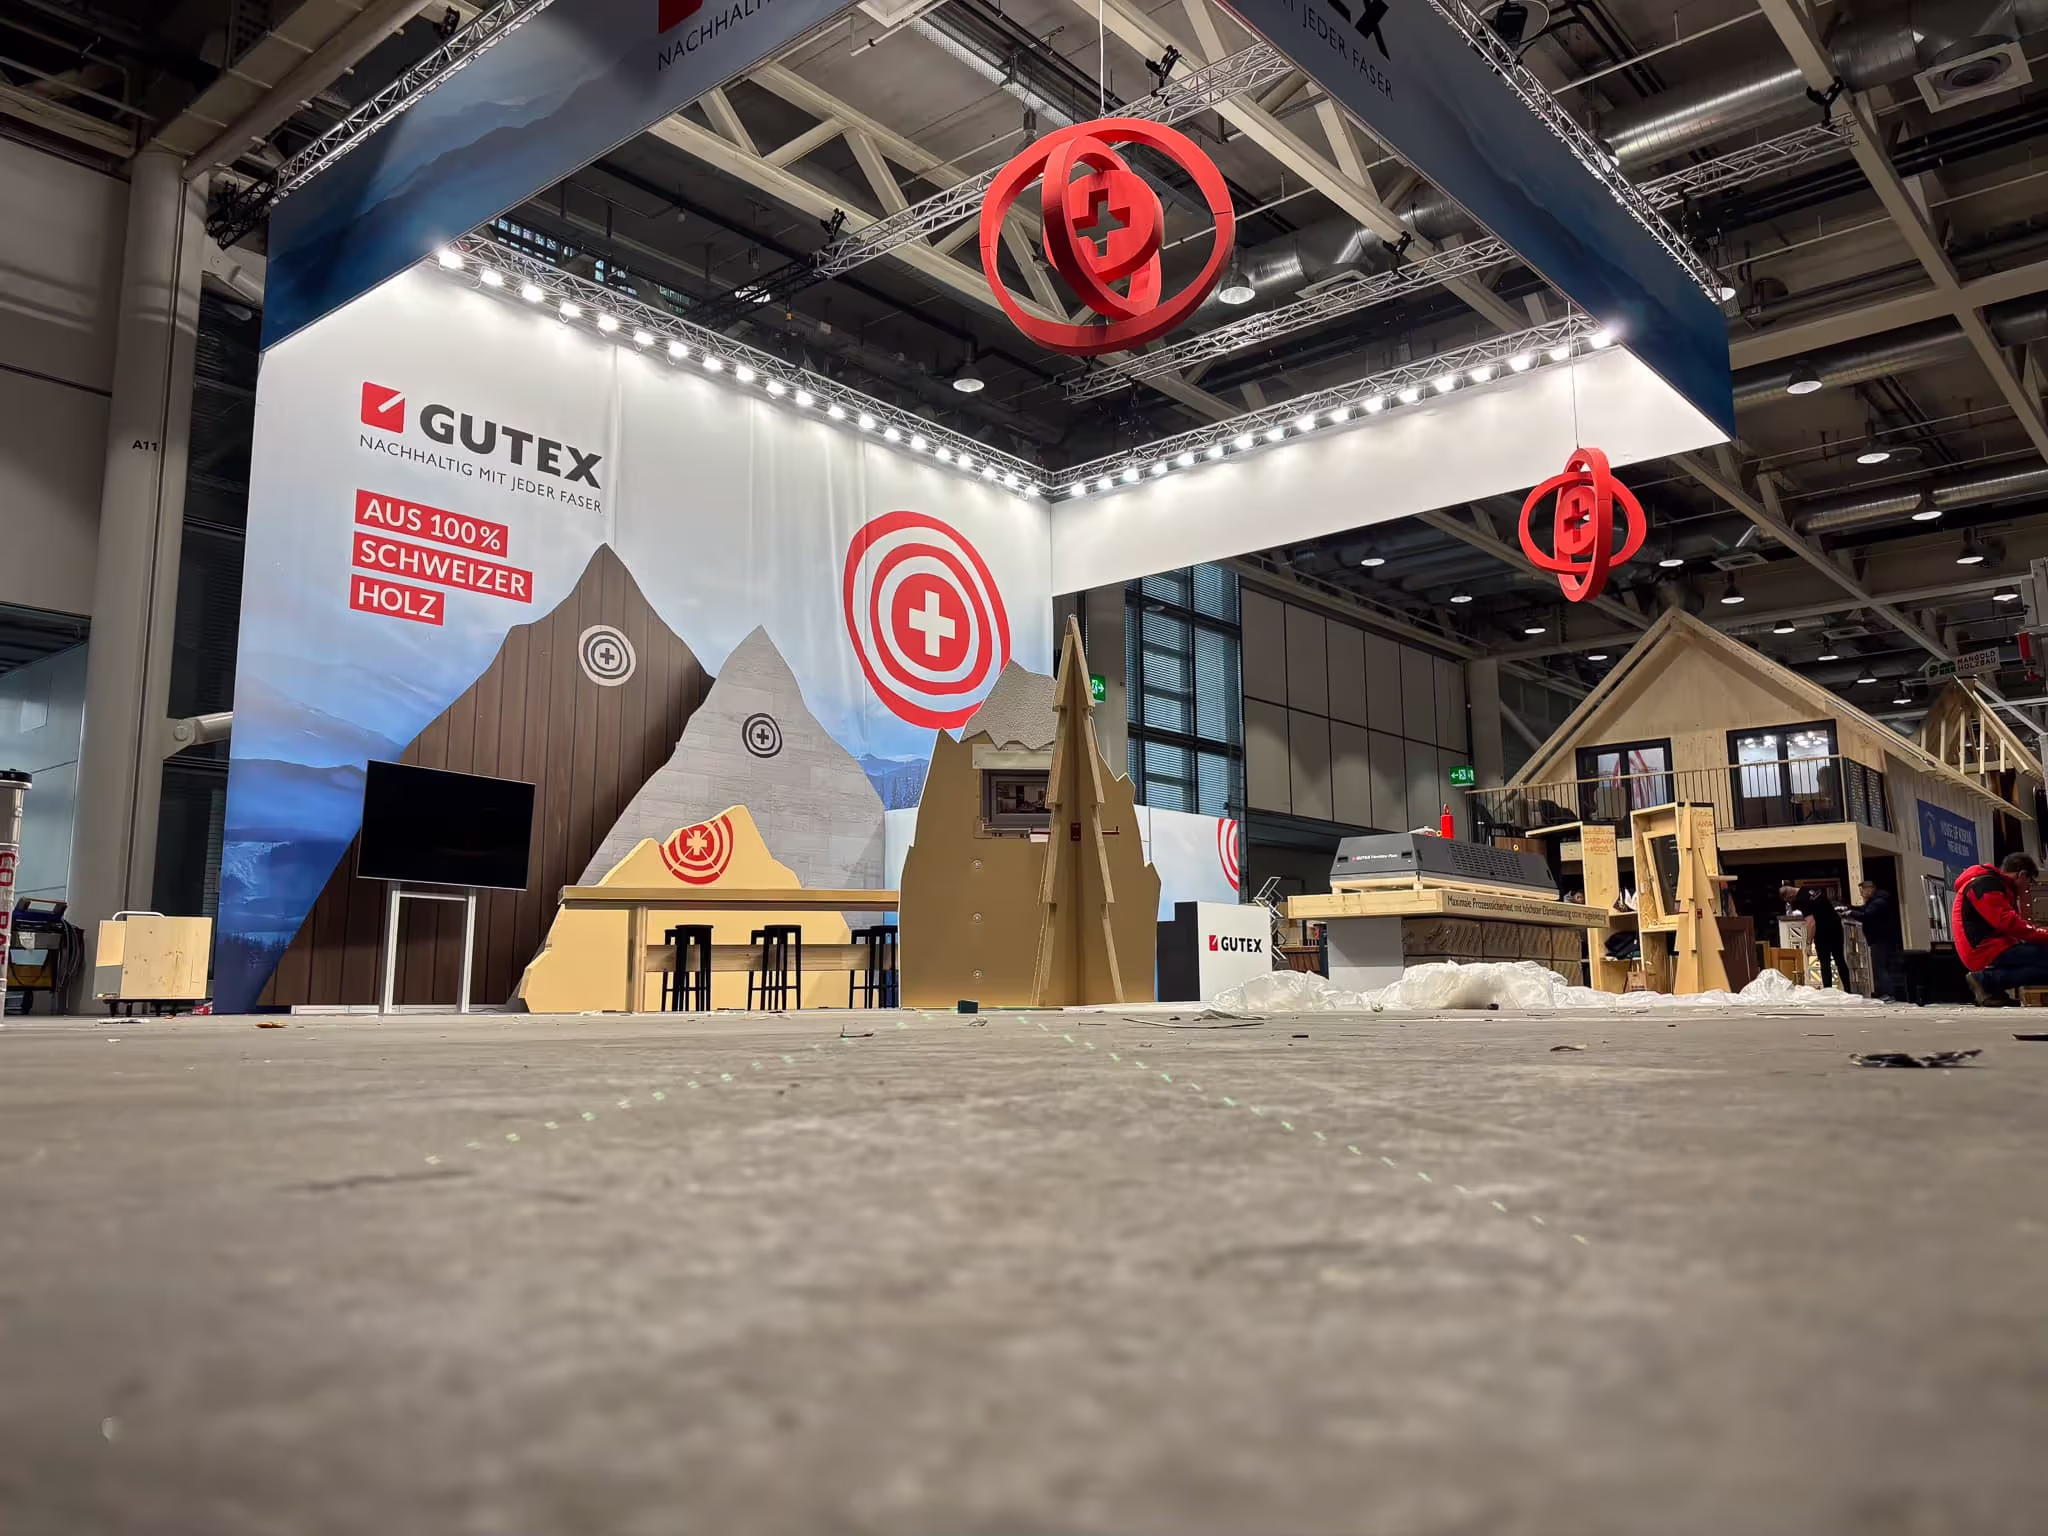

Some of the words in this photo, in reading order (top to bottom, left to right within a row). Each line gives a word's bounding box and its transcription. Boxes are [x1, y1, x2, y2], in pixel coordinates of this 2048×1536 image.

[1302, 4, 1348, 60] JEDER
[1352, 47, 1394, 102] FASER
[132, 439, 157, 451] A11
[419, 403, 603, 490] GUTEX
[359, 433, 473, 477] NACHHALTIG
[479, 466, 508, 485] MIT
[510, 475, 555, 501] JEDER
[560, 490, 602, 514] FASER
[363, 498, 422, 532] AUS
[430, 514, 501, 551] 100%
[360, 539, 527, 598] SCHWEIZER
[357, 581, 437, 619] HOLZ
[1957, 650, 1996, 665] MANGOLD
[1958, 657, 1996, 671] HOLZBAU
[1220, 935, 1264, 953] GUTEX
